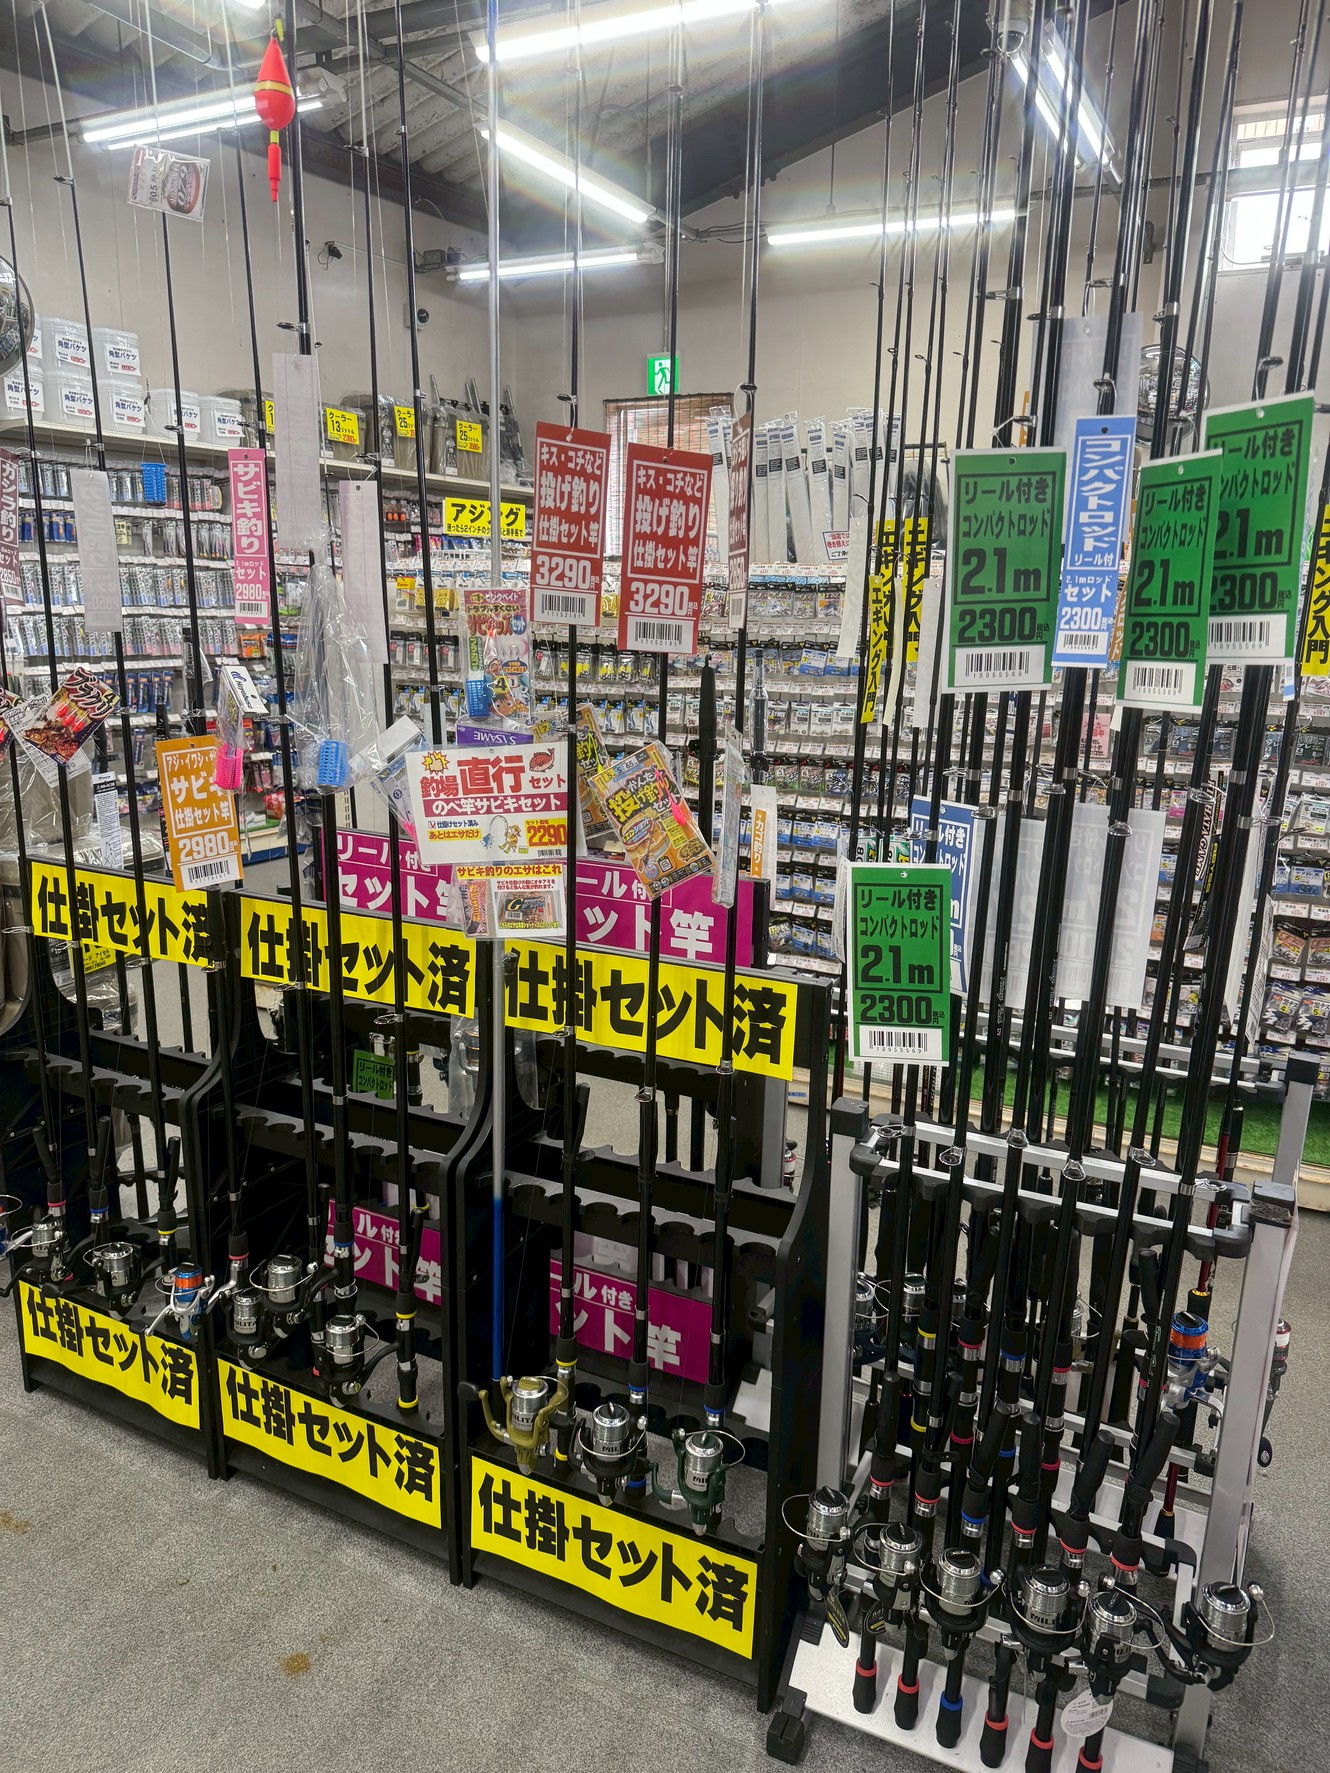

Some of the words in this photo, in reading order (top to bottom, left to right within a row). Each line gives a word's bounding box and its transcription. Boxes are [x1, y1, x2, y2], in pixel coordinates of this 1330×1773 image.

[540, 443, 602, 475] キス・コチなど
[540, 471, 600, 515] 投げ釣り
[637, 466, 703, 498] キス・コチなど
[964, 477, 1050, 505] リール付き
[1079, 440, 1125, 552] コンパクトロッド
[1219, 462, 1296, 500] ンパクトロッド
[233, 463, 263, 554] サビキ釣り
[451, 503, 520, 527] アジグ
[635, 494, 700, 539] 投げ釣り
[1145, 484, 1207, 516] リール付き
[539, 514, 600, 547] 仕掛セット竿
[962, 508, 1050, 540] コンパクトロッド
[1141, 517, 1207, 550] コンパクトロッド
[536, 555, 591, 589] 3290
[633, 540, 699, 573] 仕掛セット竿
[961, 547, 1042, 596] 2.1m
[1074, 552, 1114, 567] リール付
[236, 567, 266, 580] セット
[1066, 575, 1113, 585] 2.1mロッド
[1137, 559, 1196, 608] 2.1m
[236, 583, 262, 600] 2980
[629, 582, 689, 616] 3290
[1064, 584, 1113, 603] セット
[957, 607, 1037, 643] 2300
[1061, 606, 1102, 630] 2300
[864, 587, 884, 713] エギング入門
[1130, 621, 1190, 658] 2300
[175, 801, 230, 830] 仕掛セット竿
[432, 794, 561, 815] のべ竿サビキセット
[608, 778, 670, 823] 投げ釣り
[178, 832, 229, 863] 2980
[429, 830, 480, 840] あとはエサだけ
[527, 824, 567, 847] 2290
[457, 865, 562, 876] サビキ釣りのエサはこれ
[860, 889, 938, 911] リール付き
[37, 874, 209, 966] 仕掛セット済
[583, 903, 715, 960] ット竿
[859, 915, 940, 940] コンパクトロッド
[247, 903, 471, 1014] 仕掛セット済
[860, 944, 934, 985] 2.1m
[505, 947, 787, 1066] 仕掛セット済
[860, 994, 932, 1024] 2300
[360, 1061, 392, 1078] リール付き
[27, 1286, 195, 1406] 仕掛セット済
[226, 1366, 435, 1504] 仕掛セット済
[477, 1471, 750, 1634] 仕掛セット済
